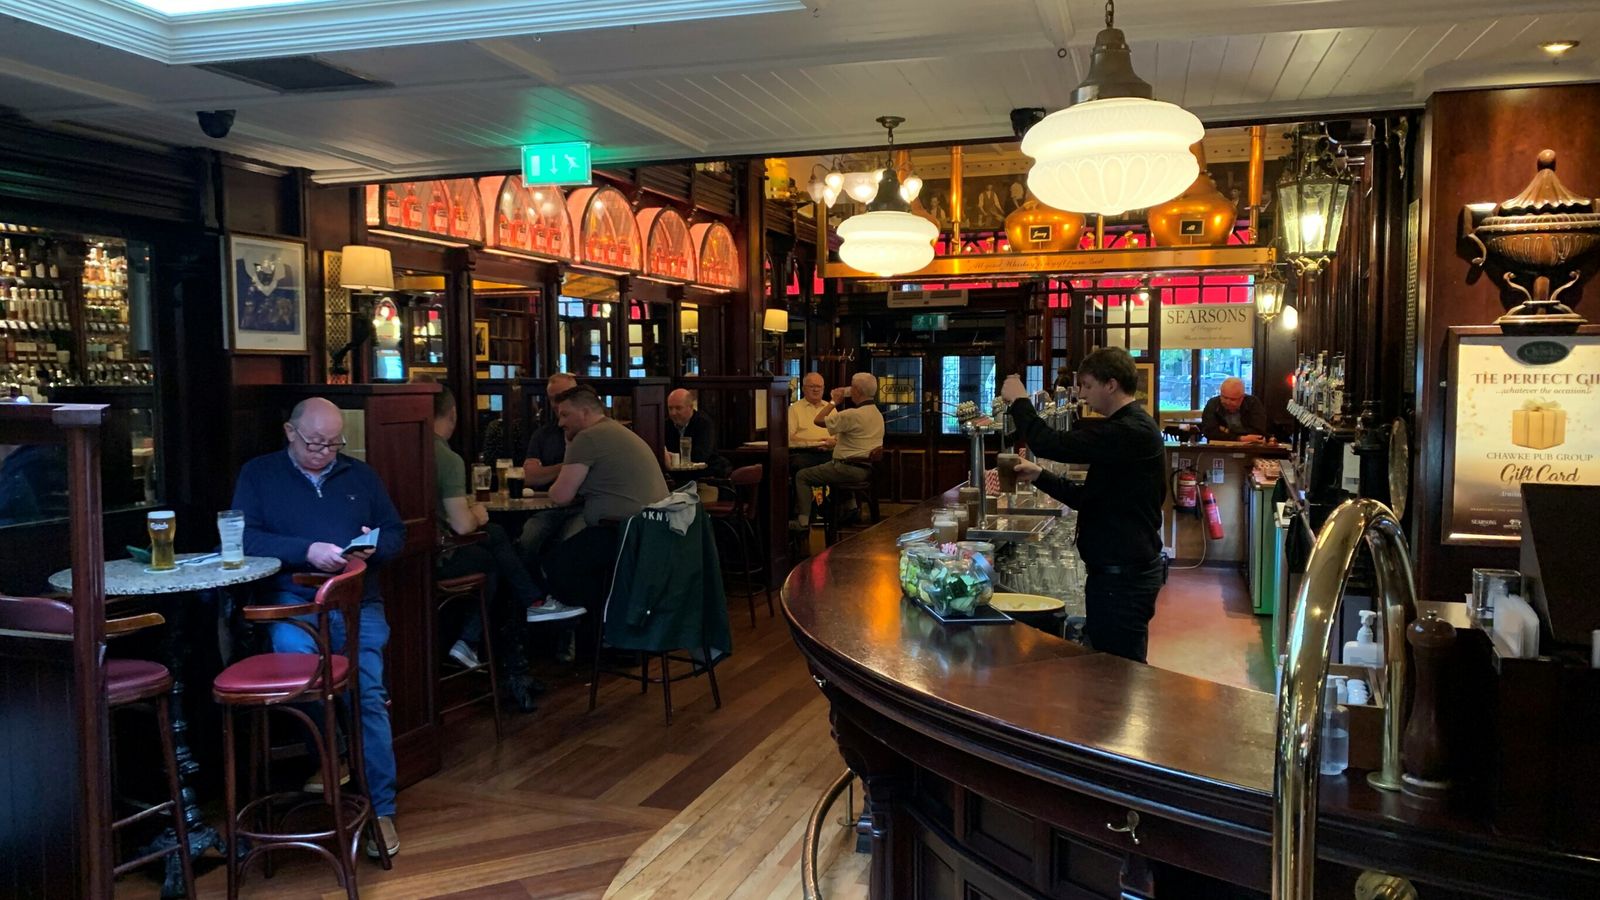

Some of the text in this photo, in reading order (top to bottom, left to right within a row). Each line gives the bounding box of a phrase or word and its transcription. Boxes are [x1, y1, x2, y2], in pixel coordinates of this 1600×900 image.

[1167, 308, 1247, 325] SEARSONS
[1471, 373, 1498, 385] THE
[1503, 373, 1573, 385] PERFECT
[1540, 387, 1551, 395] the
[1486, 452, 1594, 461] CHAWKE PUB GROUP
[1500, 463, 1580, 485] Gift Card
